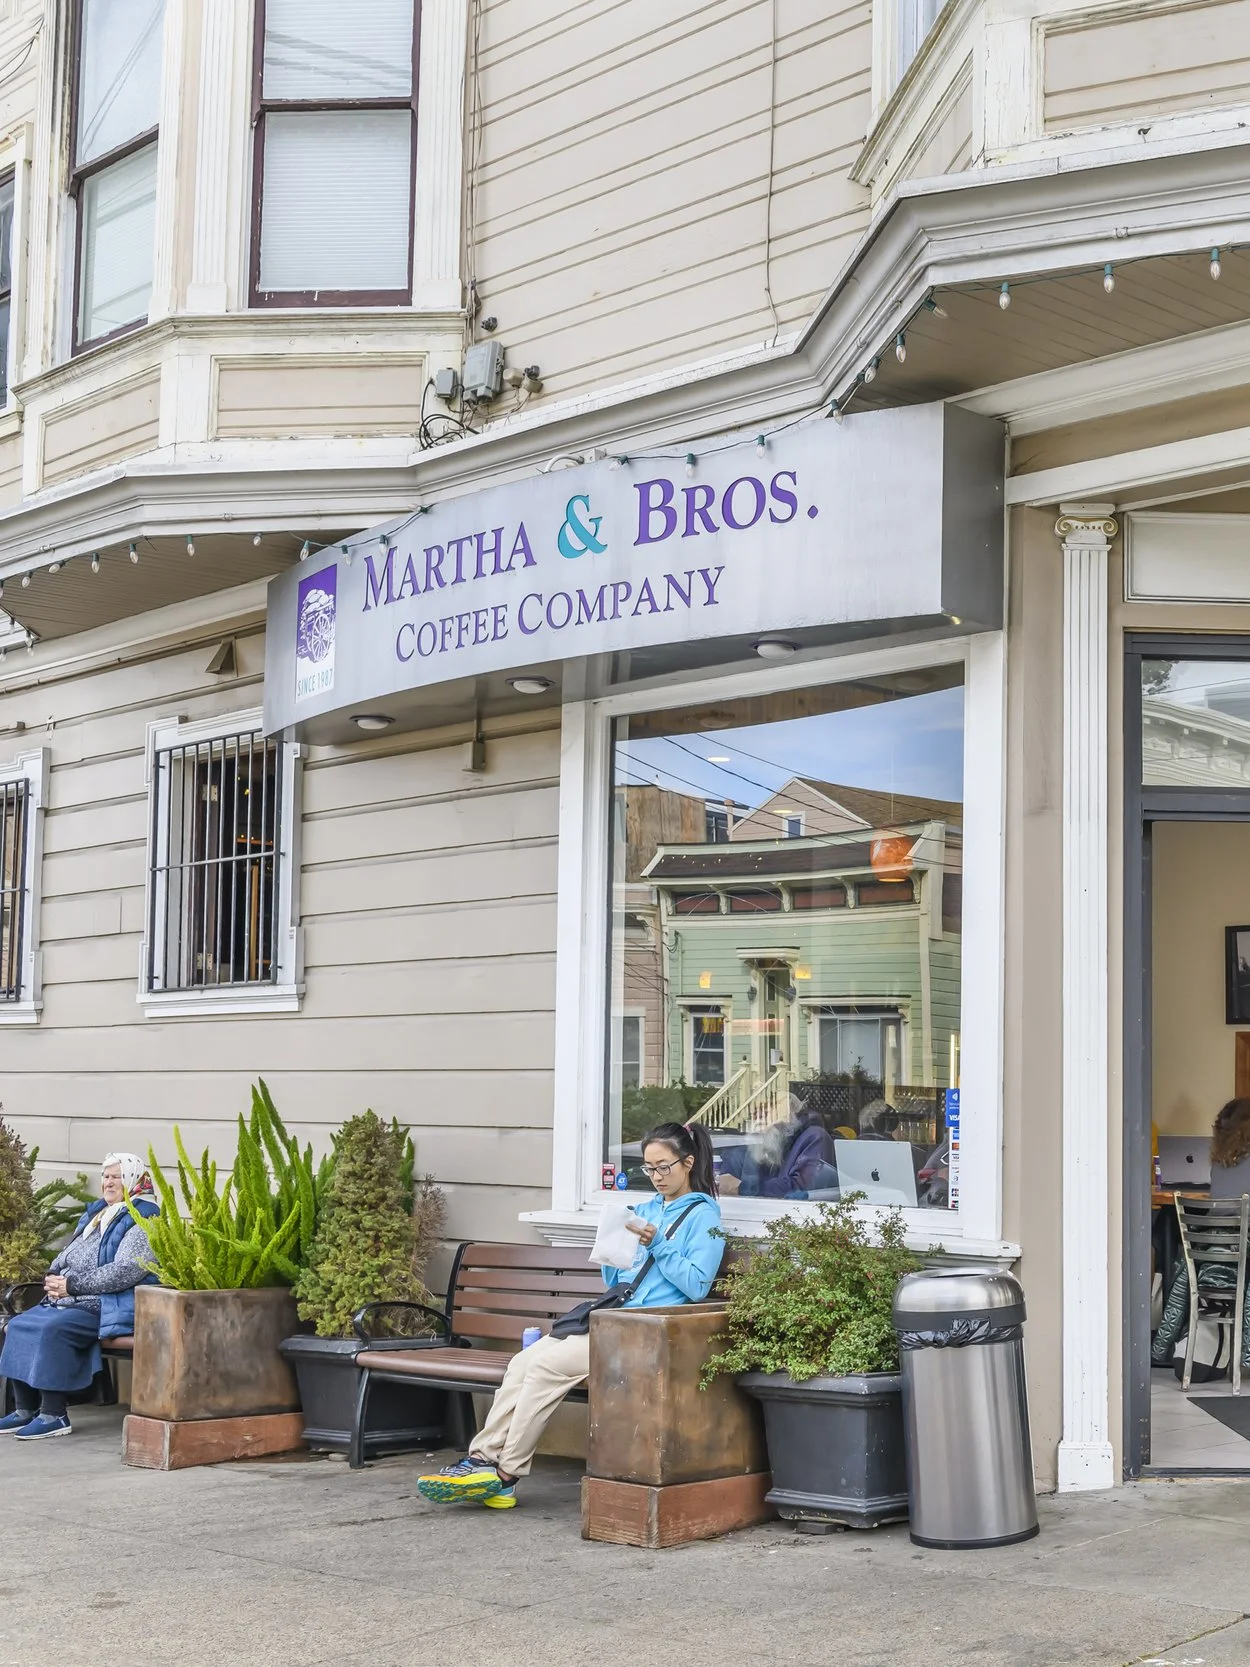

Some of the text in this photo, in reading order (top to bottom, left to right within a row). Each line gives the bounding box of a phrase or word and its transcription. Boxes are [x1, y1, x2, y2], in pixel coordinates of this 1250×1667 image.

[362, 471, 819, 612] MARTHA & BROS.
[395, 565, 726, 663] COFFEE COMPANY
[297, 668, 333, 697] SINCE 1987
